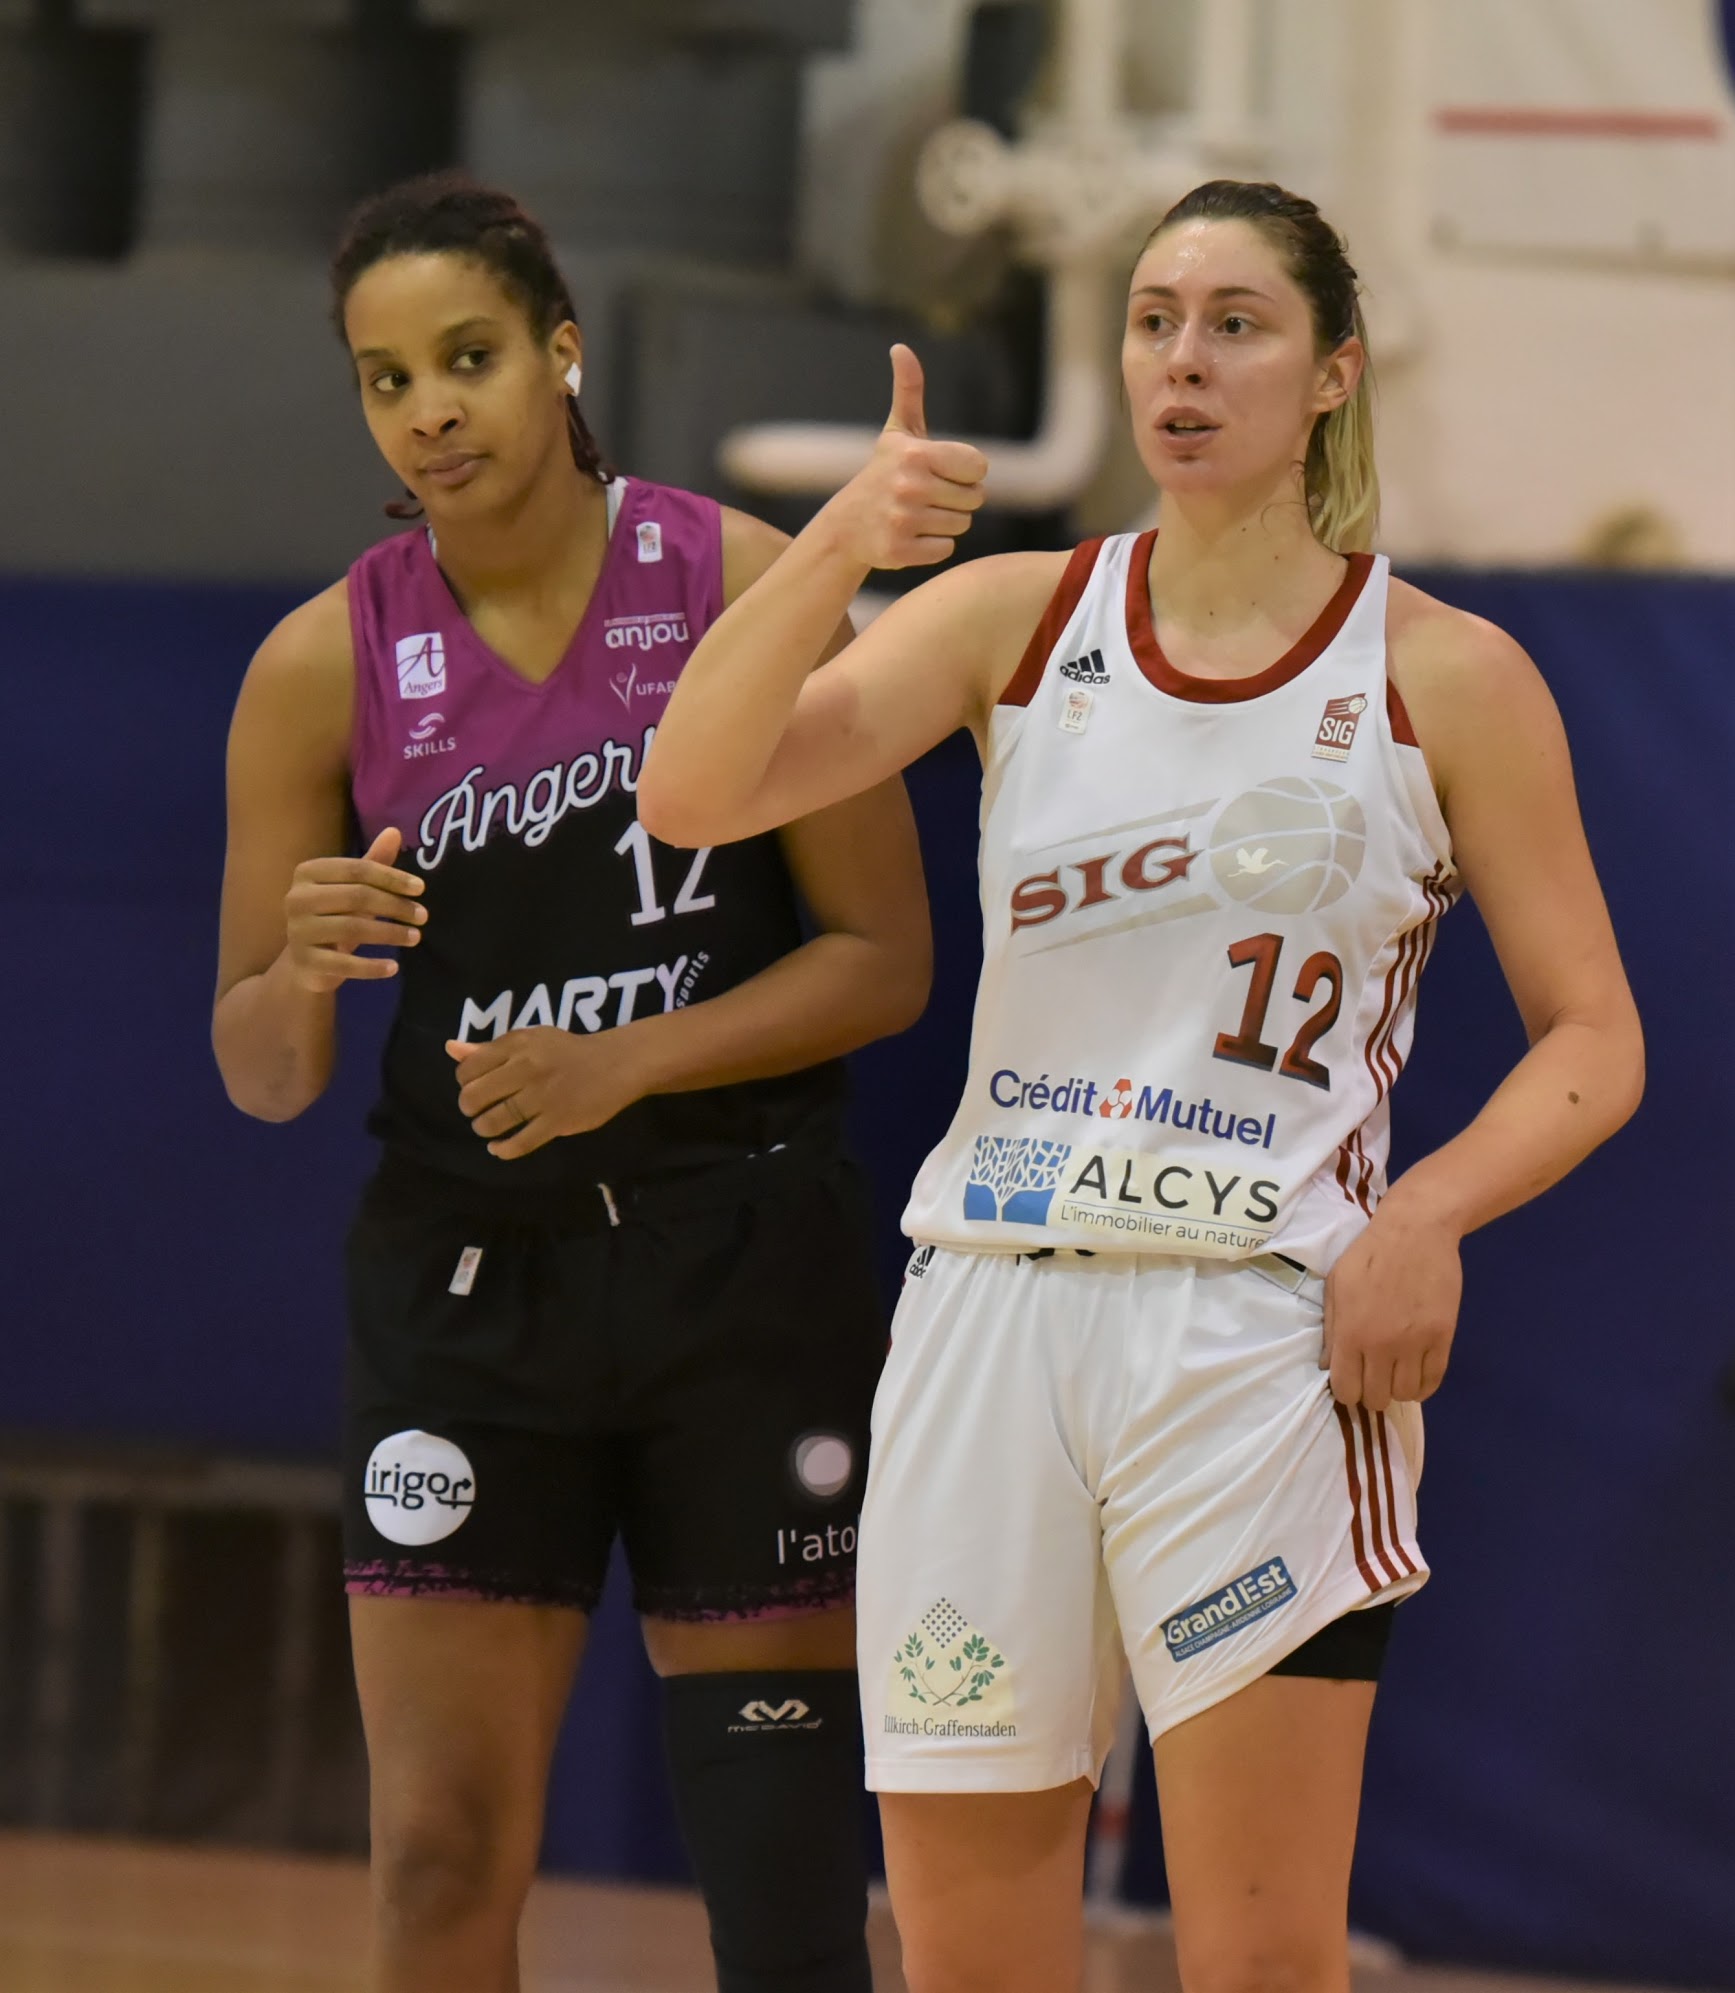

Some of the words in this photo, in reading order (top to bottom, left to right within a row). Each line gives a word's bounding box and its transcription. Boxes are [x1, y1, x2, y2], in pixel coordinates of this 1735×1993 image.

[605, 618, 690, 651] anjou
[404, 680, 443, 696] Angers
[1059, 665, 1111, 685] adidas
[404, 737, 457, 760] SKILLS
[1319, 717, 1355, 745] SIG
[1010, 832, 1205, 937] SIG
[457, 954, 688, 1041] MARTY
[676, 951, 709, 1008] sports
[1213, 933, 1343, 1092] 12
[989, 1069, 1098, 1116] Crédit
[1134, 1085, 1276, 1149] Mutuel
[1070, 1155, 1281, 1223] ALCYS
[1061, 1205, 1172, 1235] L'immobilier
[1175, 1225, 1199, 1240] au
[1205, 1230, 1270, 1248] nature
[777, 1514, 861, 1564] l'ato
[884, 1714, 1017, 1737] Illkirch-Graffenstaden
